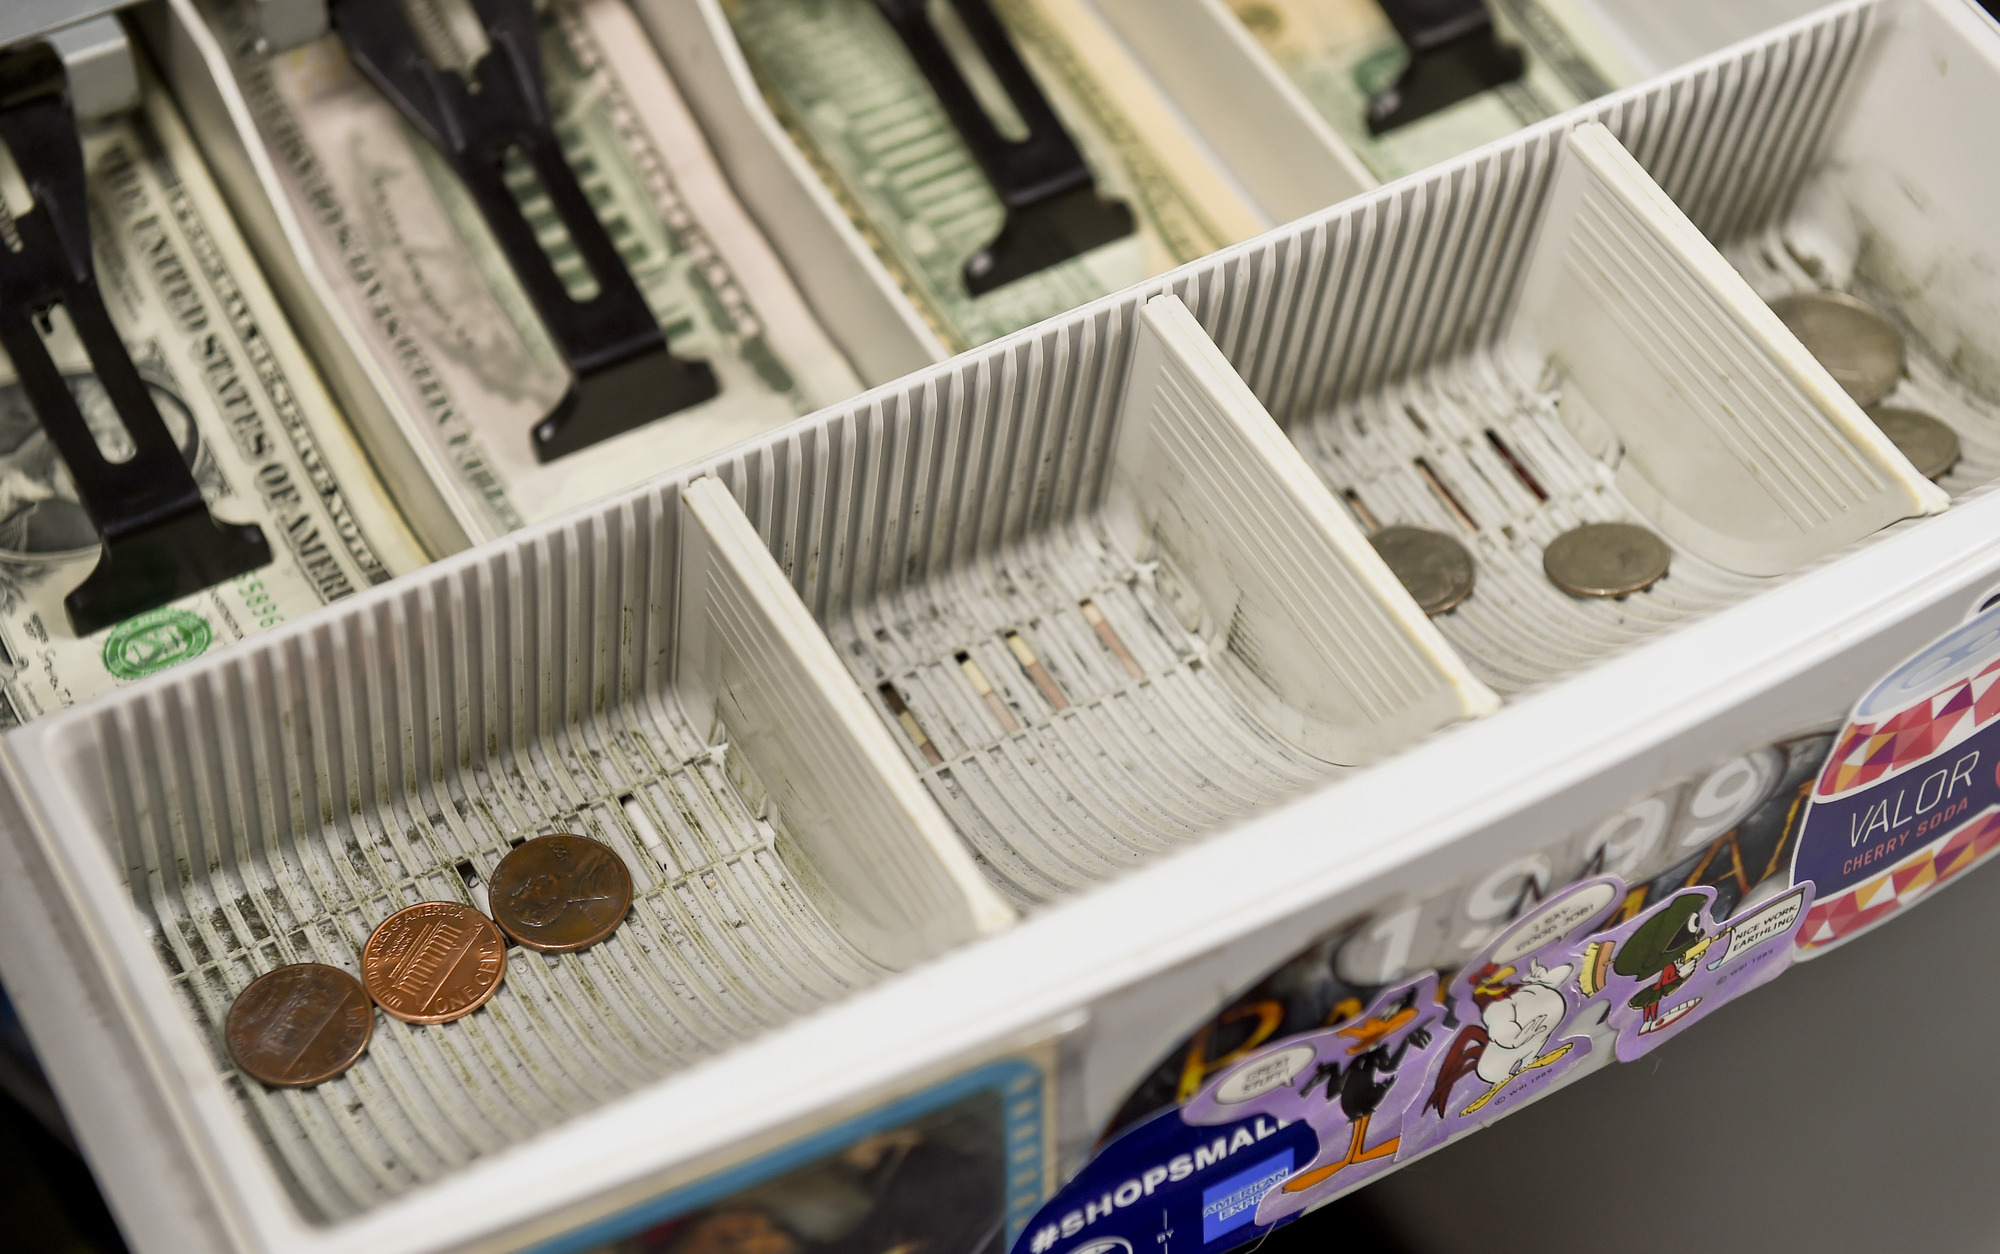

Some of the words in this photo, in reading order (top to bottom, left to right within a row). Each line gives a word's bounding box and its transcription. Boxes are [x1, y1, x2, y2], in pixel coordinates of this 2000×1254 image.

[129, 211, 214, 338] UNITED
[189, 329, 275, 461] STATES
[258, 458, 303, 514] OF
[1851, 751, 1980, 848] VALOR
[1373, 756, 1756, 984] 1999
[1843, 834, 1910, 875] CHERRY
[1916, 797, 1968, 838] SODA
[367, 929, 392, 969] STATES
[391, 919, 402, 932] OF
[404, 905, 465, 924] AMERICA
[1516, 925, 1557, 951] GOOD
[1735, 923, 1761, 941] NICE
[435, 985, 479, 1014] ONE
[475, 939, 499, 986] CENT
[1030, 1118, 1292, 1254] #SHOPSMALL
[1203, 1167, 1290, 1217] AMERICAN
[1218, 1193, 1266, 1222] EXPR
[1156, 1229, 1174, 1243] BY
